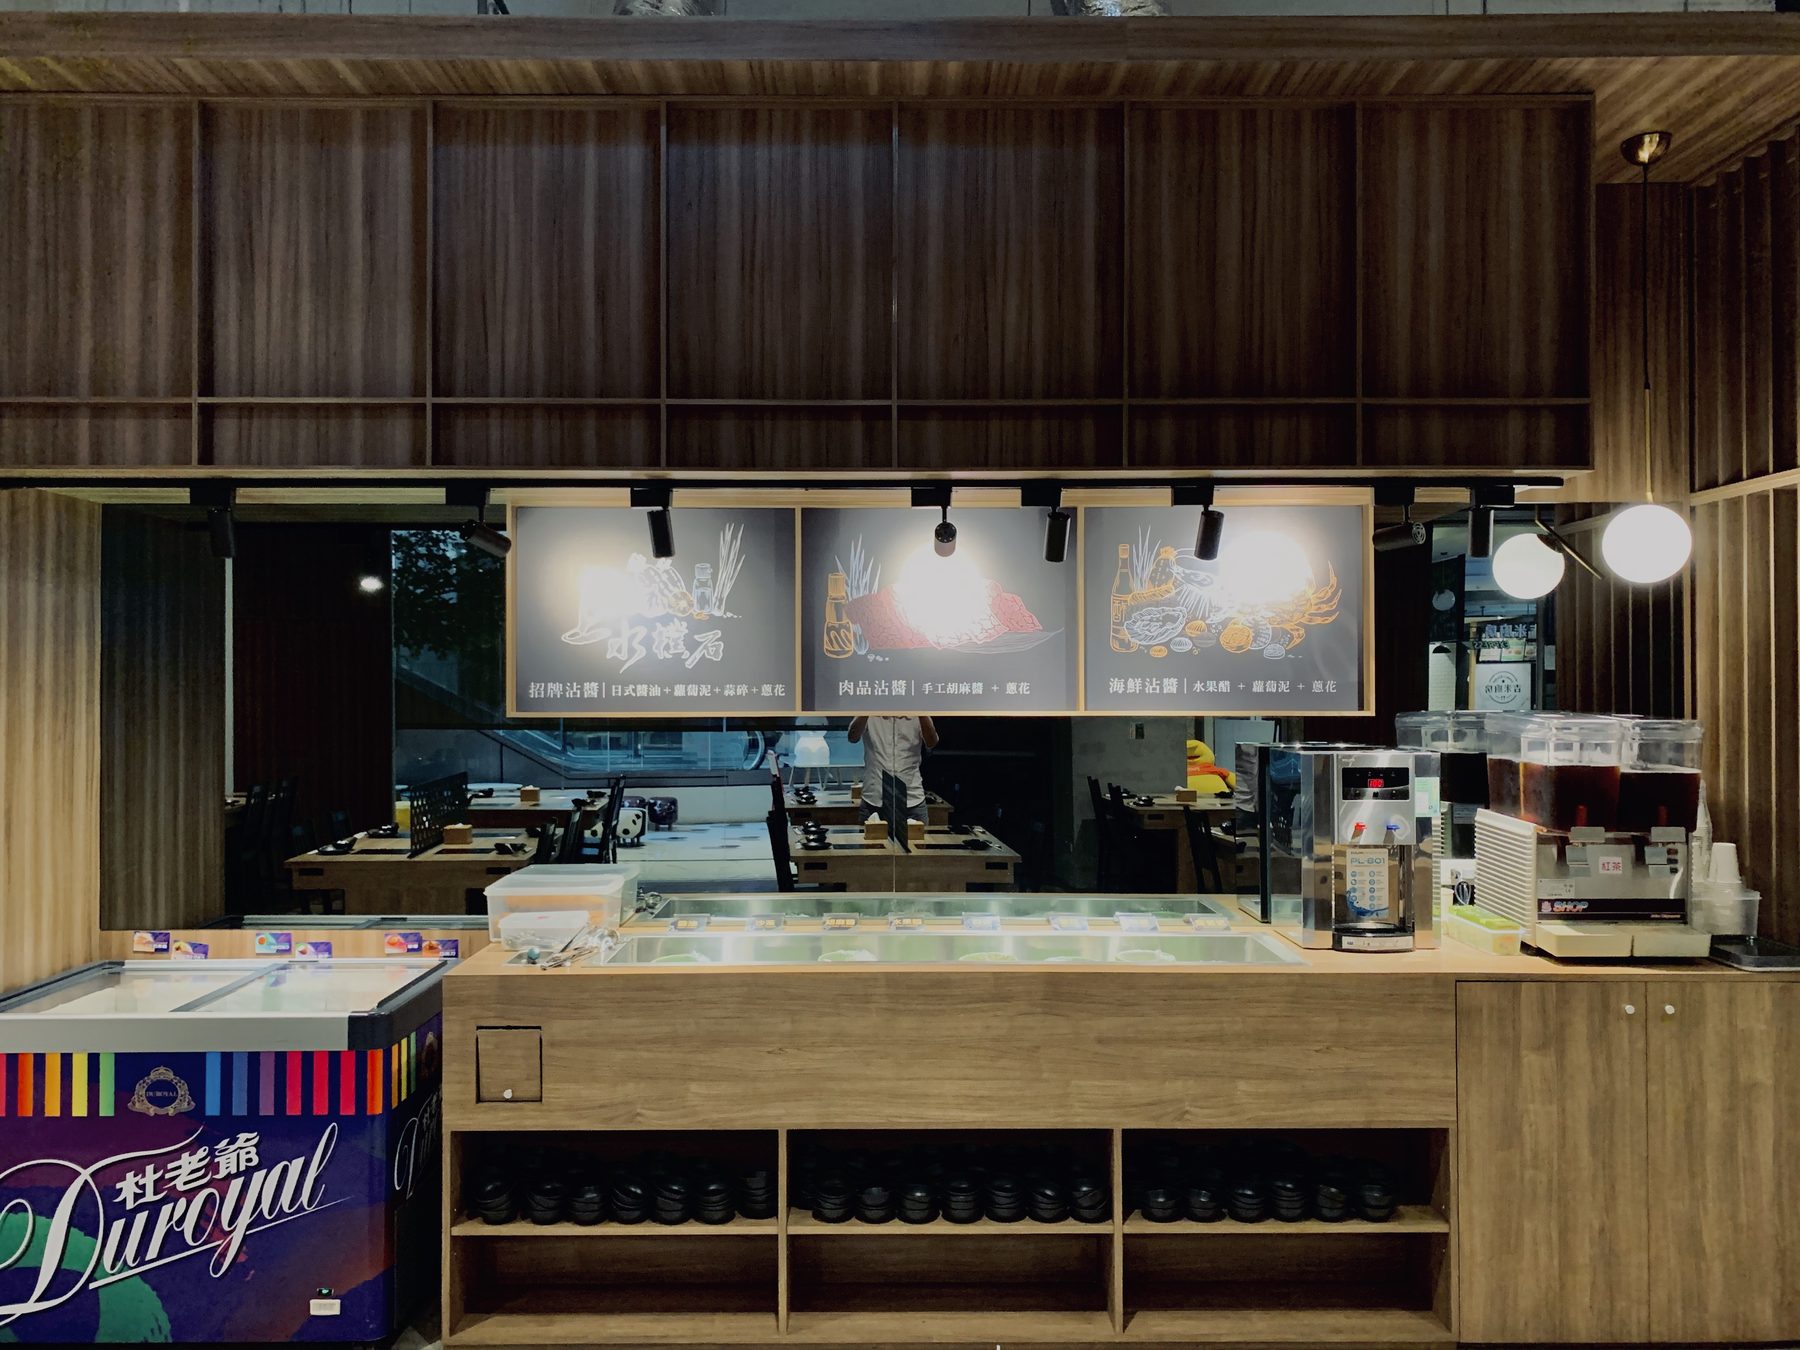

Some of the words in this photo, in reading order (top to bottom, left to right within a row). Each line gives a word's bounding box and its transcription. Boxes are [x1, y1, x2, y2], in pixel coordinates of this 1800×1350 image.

[528, 681, 599, 698] 招牌沾醬
[838, 679, 907, 696] 肉品沾醬
[1109, 677, 1178, 694] 海鮮沾醬
[1192, 680, 1231, 693] 水果醋
[1601, 861, 1623, 872] 紅茶
[113, 1131, 262, 1211] 杜老爺
[0, 1122, 340, 1327] Duroyal
